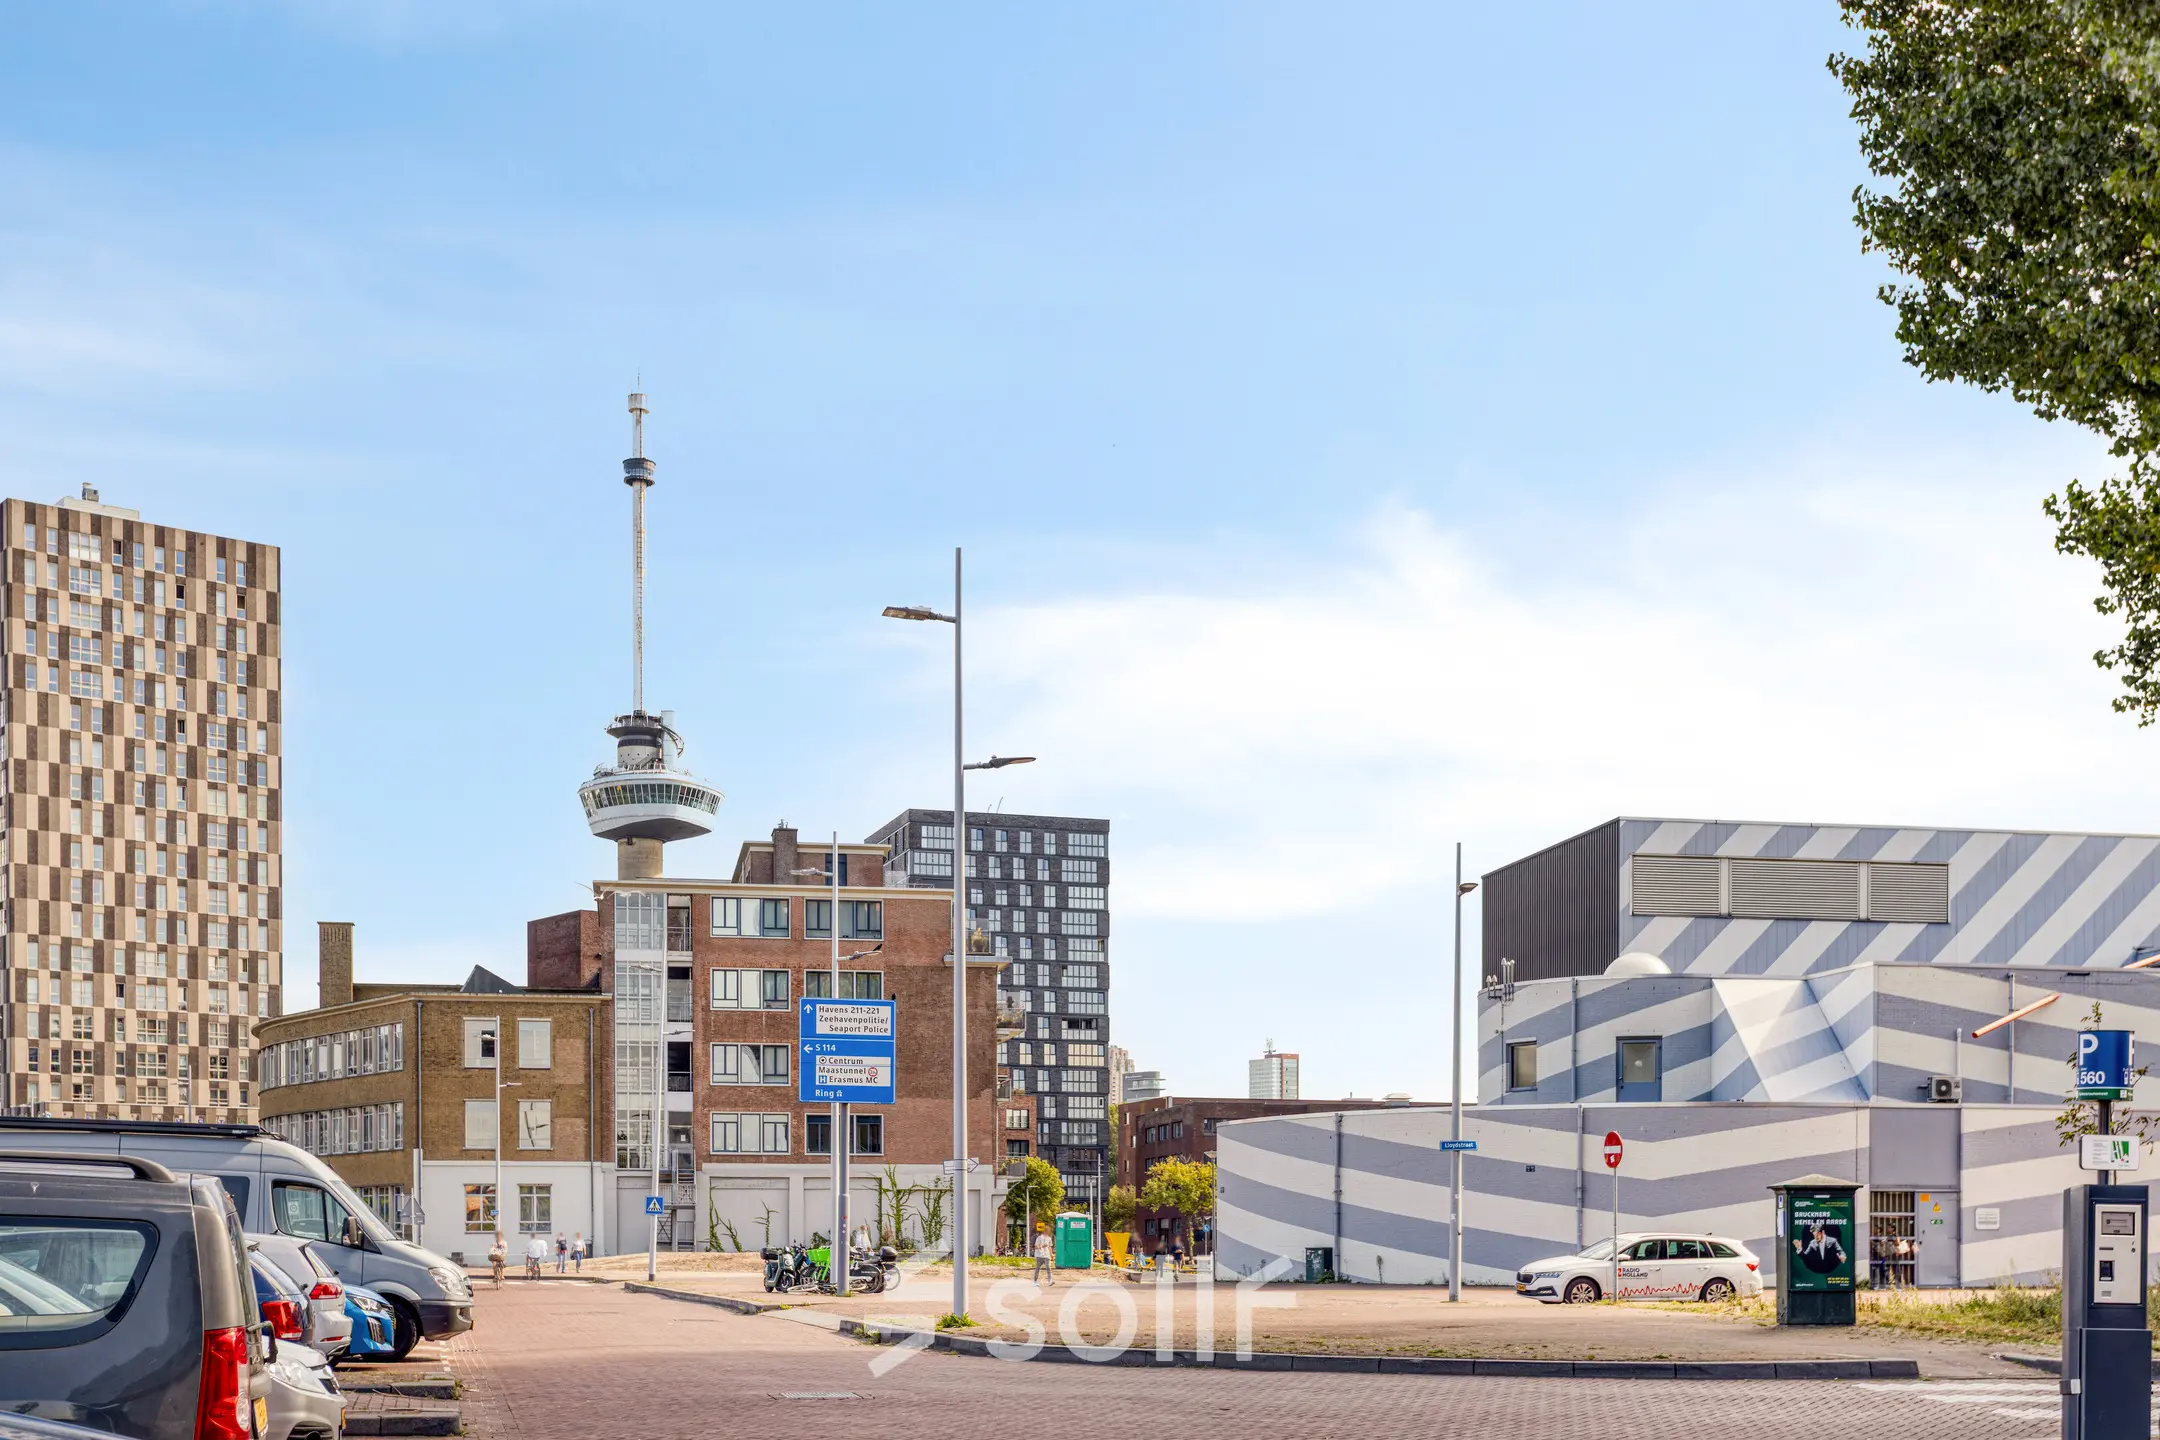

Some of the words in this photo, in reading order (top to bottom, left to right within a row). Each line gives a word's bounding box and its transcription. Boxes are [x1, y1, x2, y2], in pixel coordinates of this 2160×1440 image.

[850, 1006, 880, 1014] 211-221
[819, 1015, 889, 1024] Zeehavenpolitie/
[829, 1025, 861, 1033] Seaport
[2079, 1033, 2099, 1066] P
[828, 1057, 864, 1065] Centrum
[2080, 1070, 2106, 1085] 560
[815, 1089, 834, 1098] Ring
